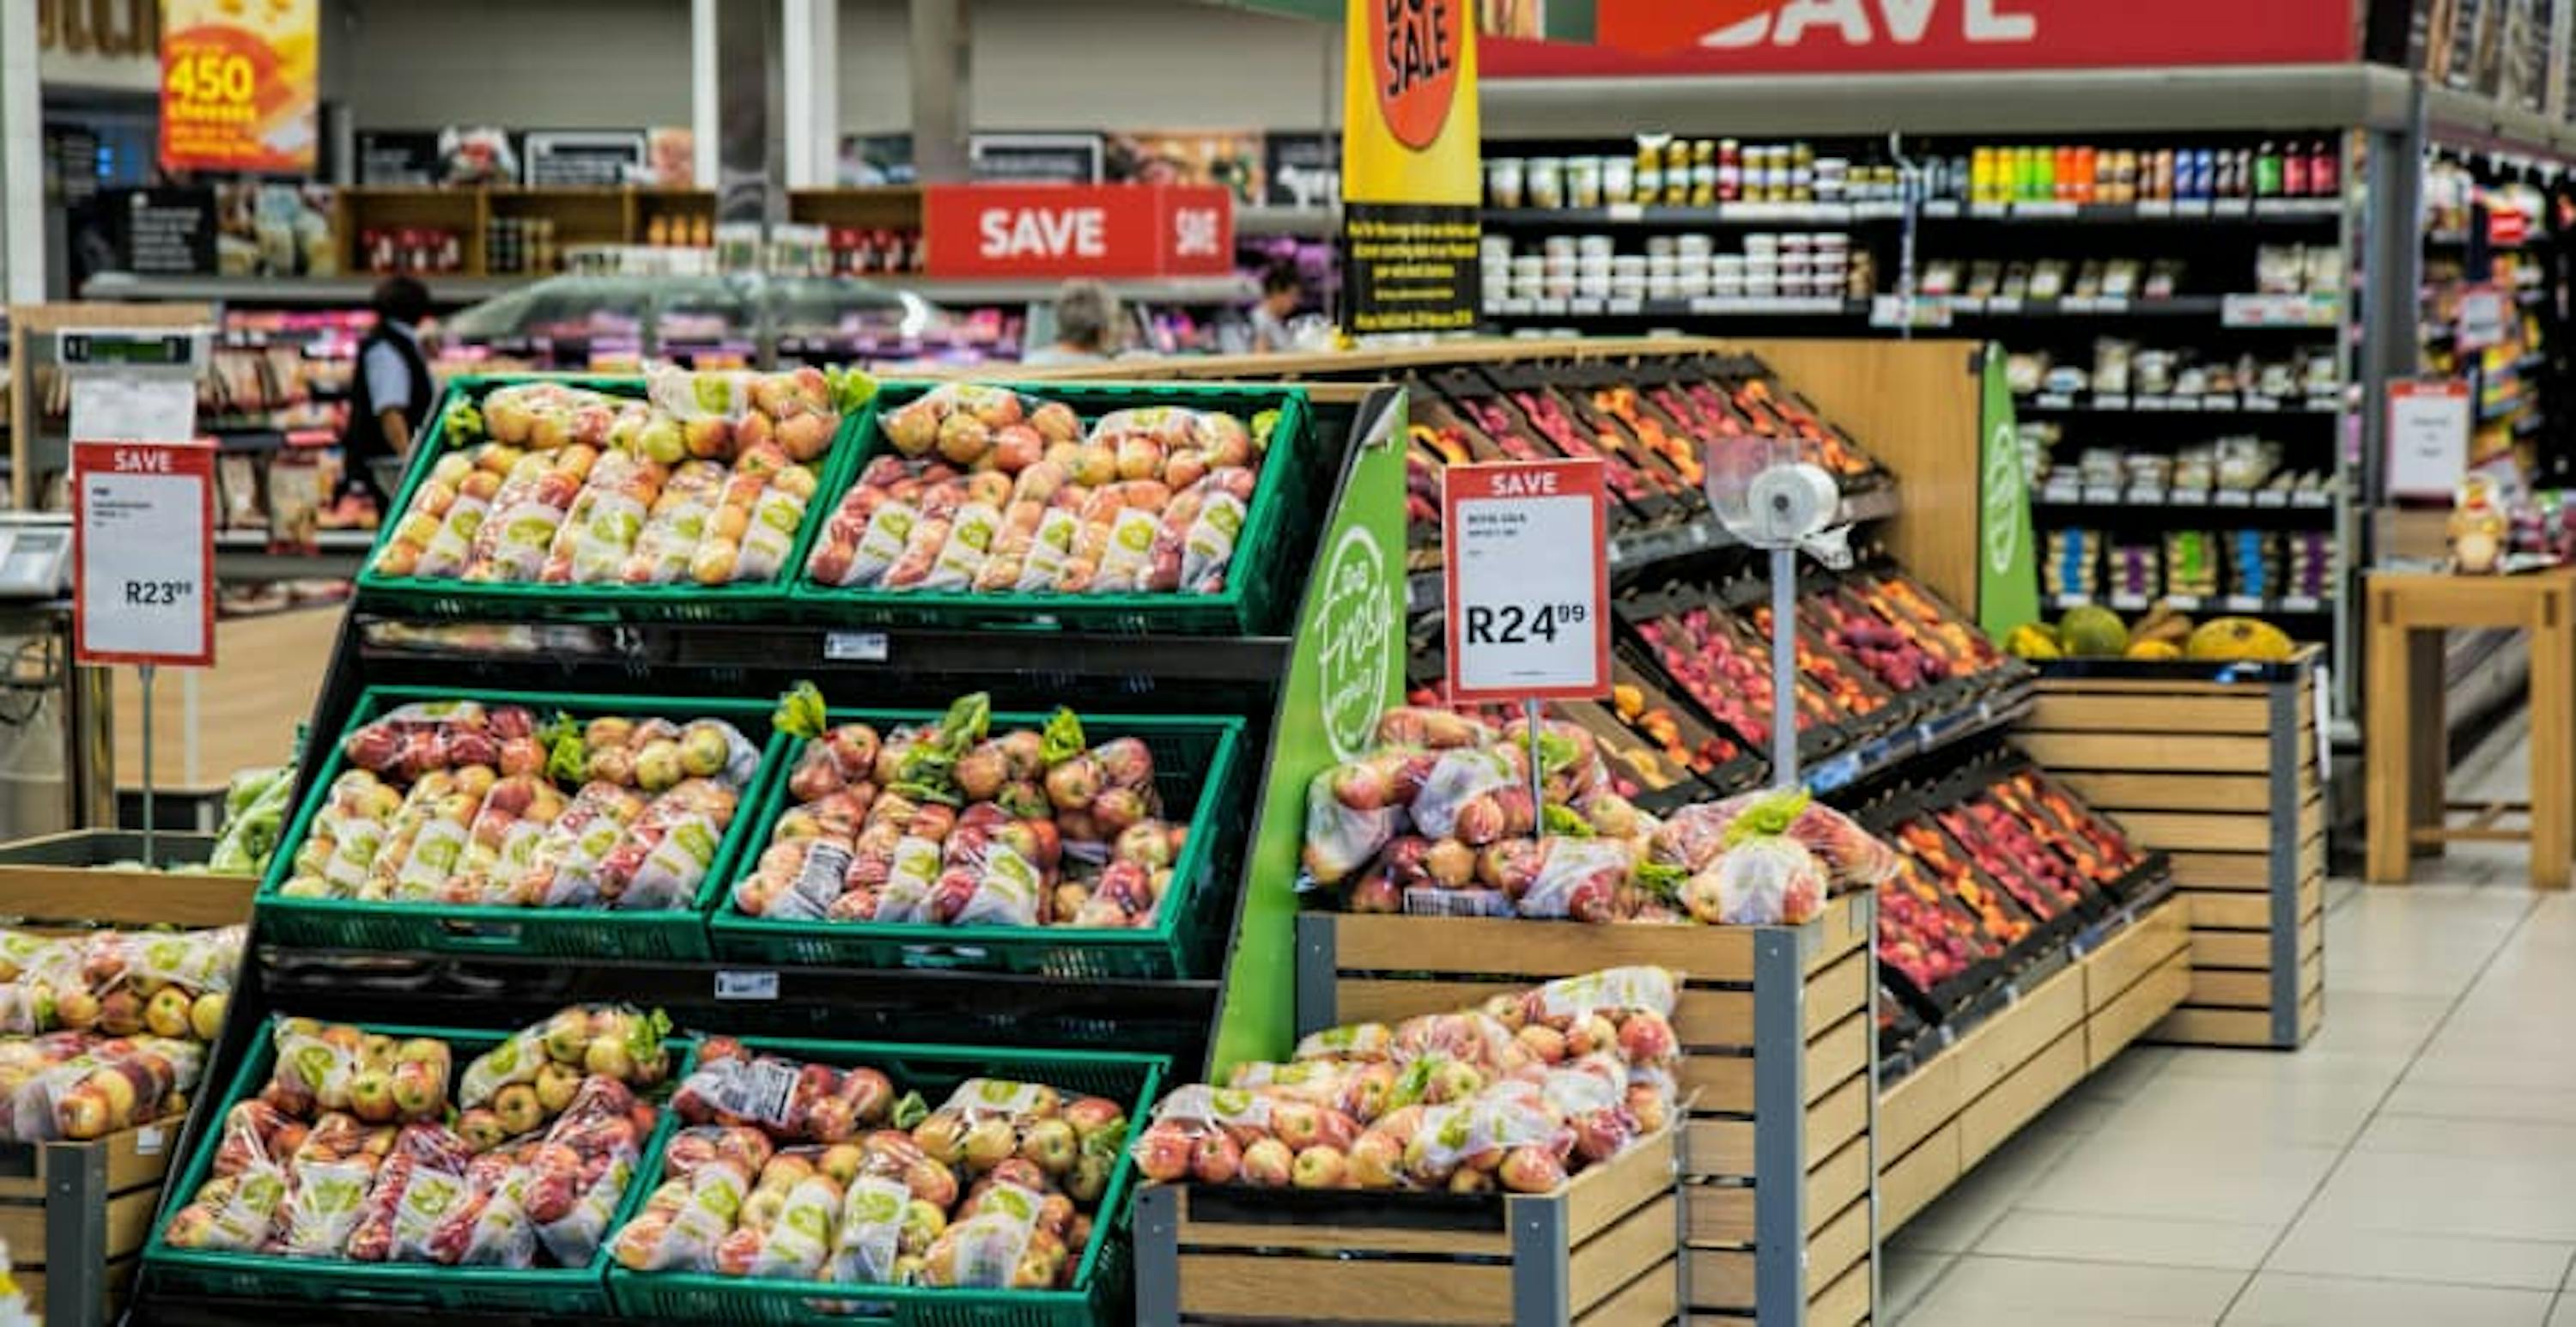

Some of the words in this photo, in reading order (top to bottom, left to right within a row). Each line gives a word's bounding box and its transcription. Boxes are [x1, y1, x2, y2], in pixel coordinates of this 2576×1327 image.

[1388, 4, 1450, 95] SALE
[167, 56, 253, 102] 450
[981, 208, 1106, 256] SAVE
[113, 447, 173, 472] SAVE
[1491, 471, 1558, 496] SAVE
